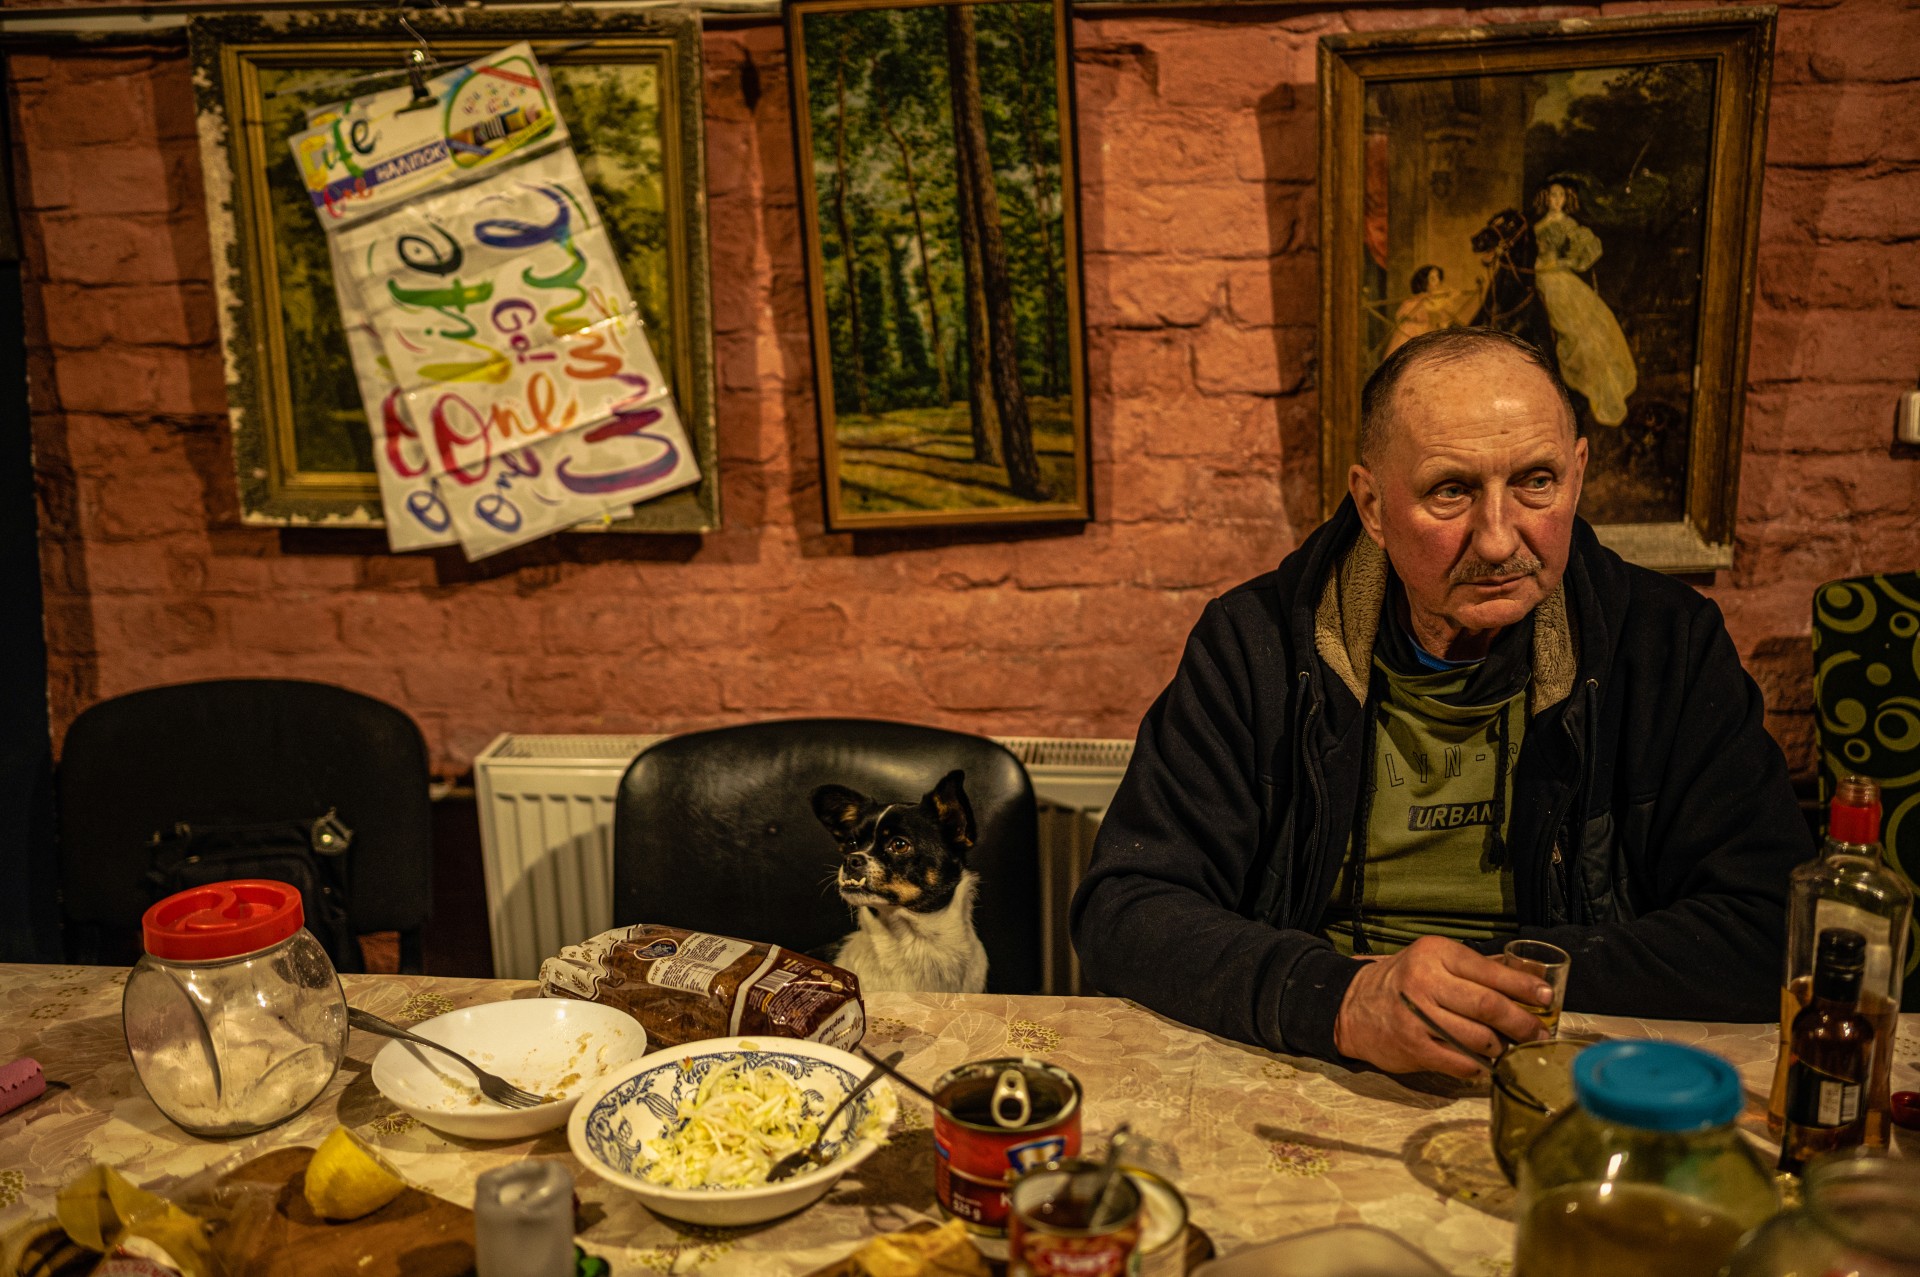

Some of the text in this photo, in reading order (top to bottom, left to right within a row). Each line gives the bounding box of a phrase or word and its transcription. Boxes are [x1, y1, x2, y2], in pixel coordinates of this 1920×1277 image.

[492, 297, 558, 364] Go!
[432, 372, 577, 486] One
[1416, 803, 1495, 828] URBAN
